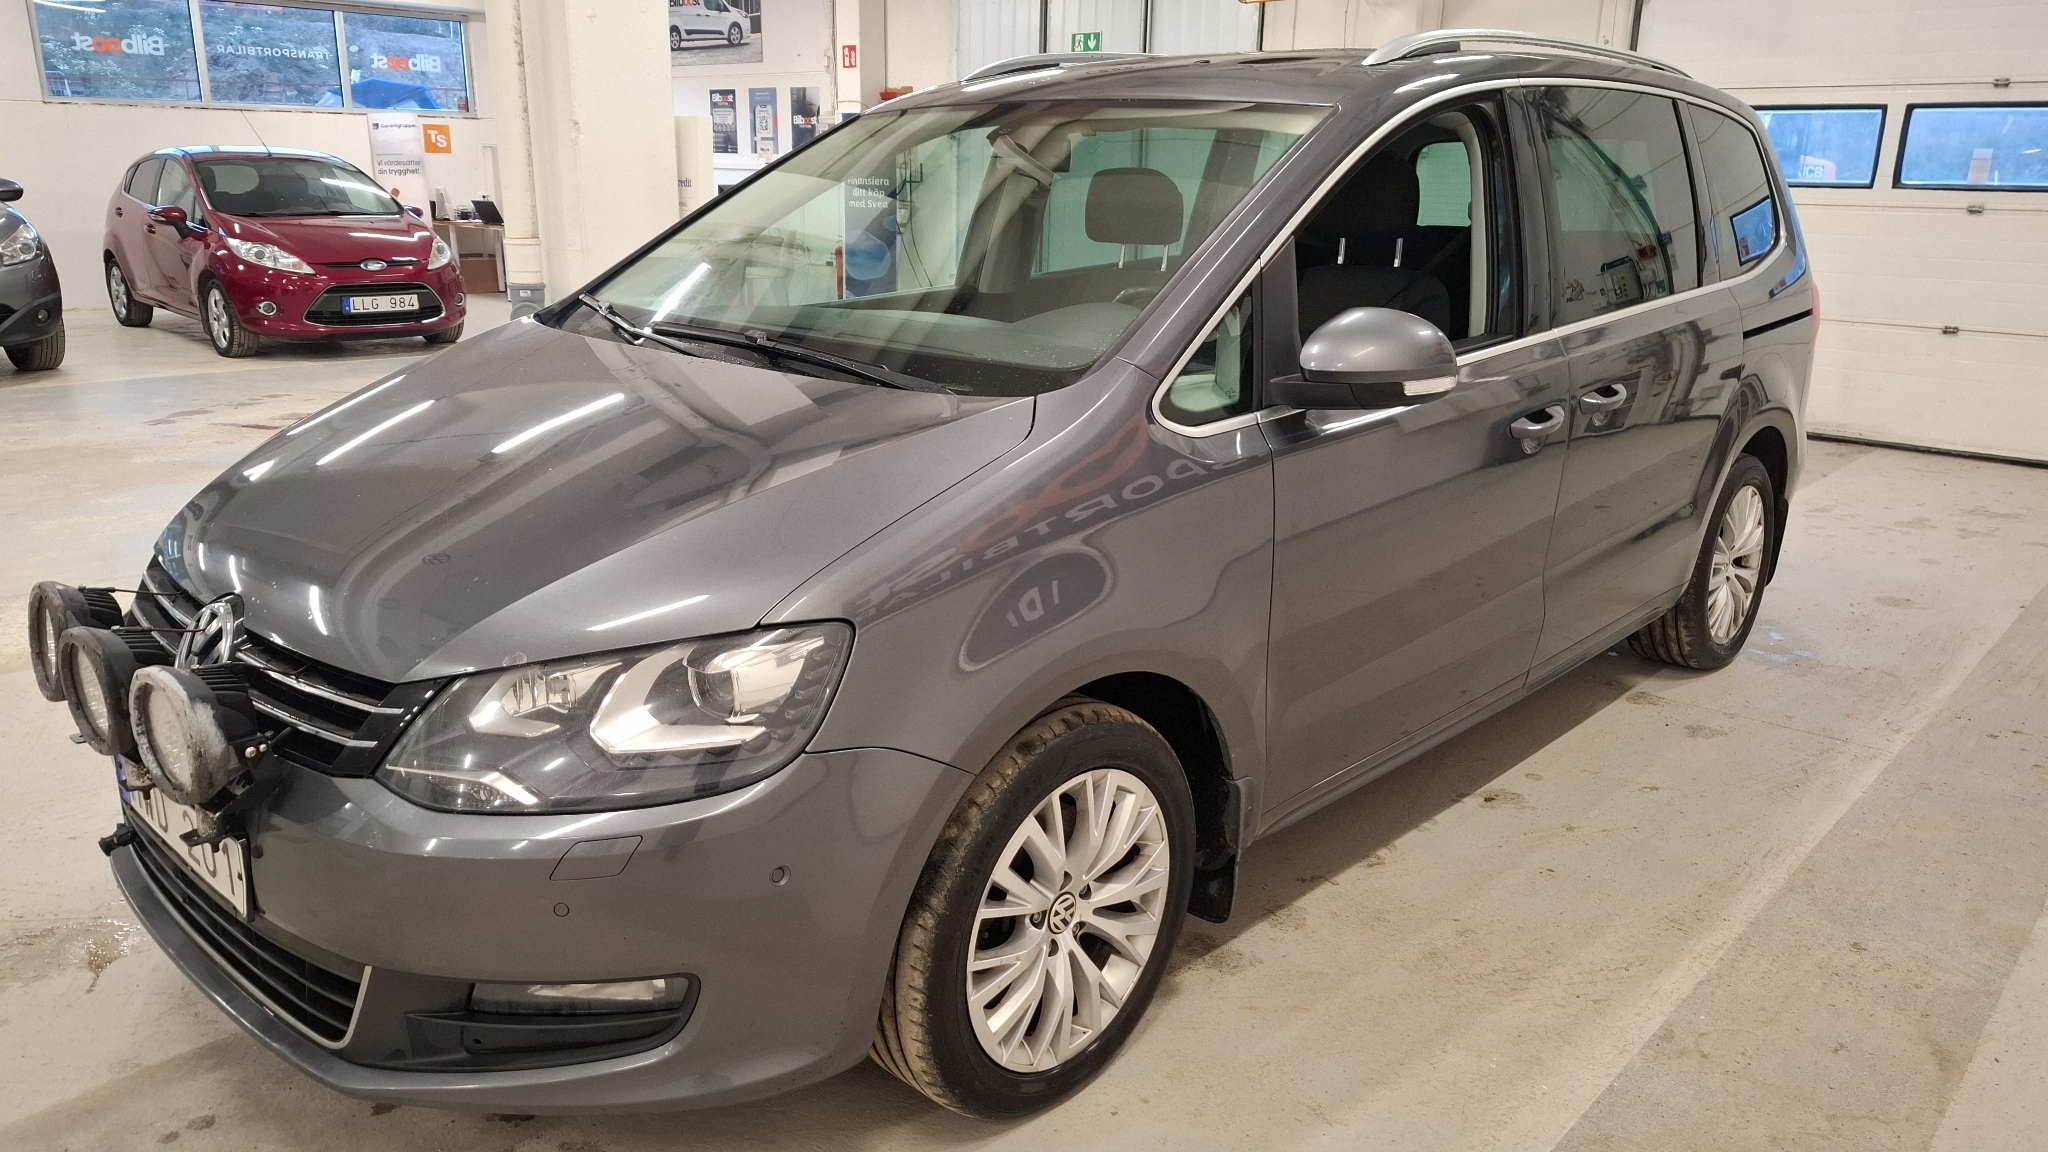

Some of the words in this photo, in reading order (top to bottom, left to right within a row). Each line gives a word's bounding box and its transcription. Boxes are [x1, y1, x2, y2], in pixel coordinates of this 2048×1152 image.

[427, 130, 447, 148] TS
[389, 168, 420, 176] trygghet!
[853, 187, 866, 197] ditt
[868, 188, 885, 199] köp
[848, 199, 866, 208] med
[867, 199, 889, 209] Svea
[353, 298, 379, 310] LLG
[389, 296, 415, 309] 984
